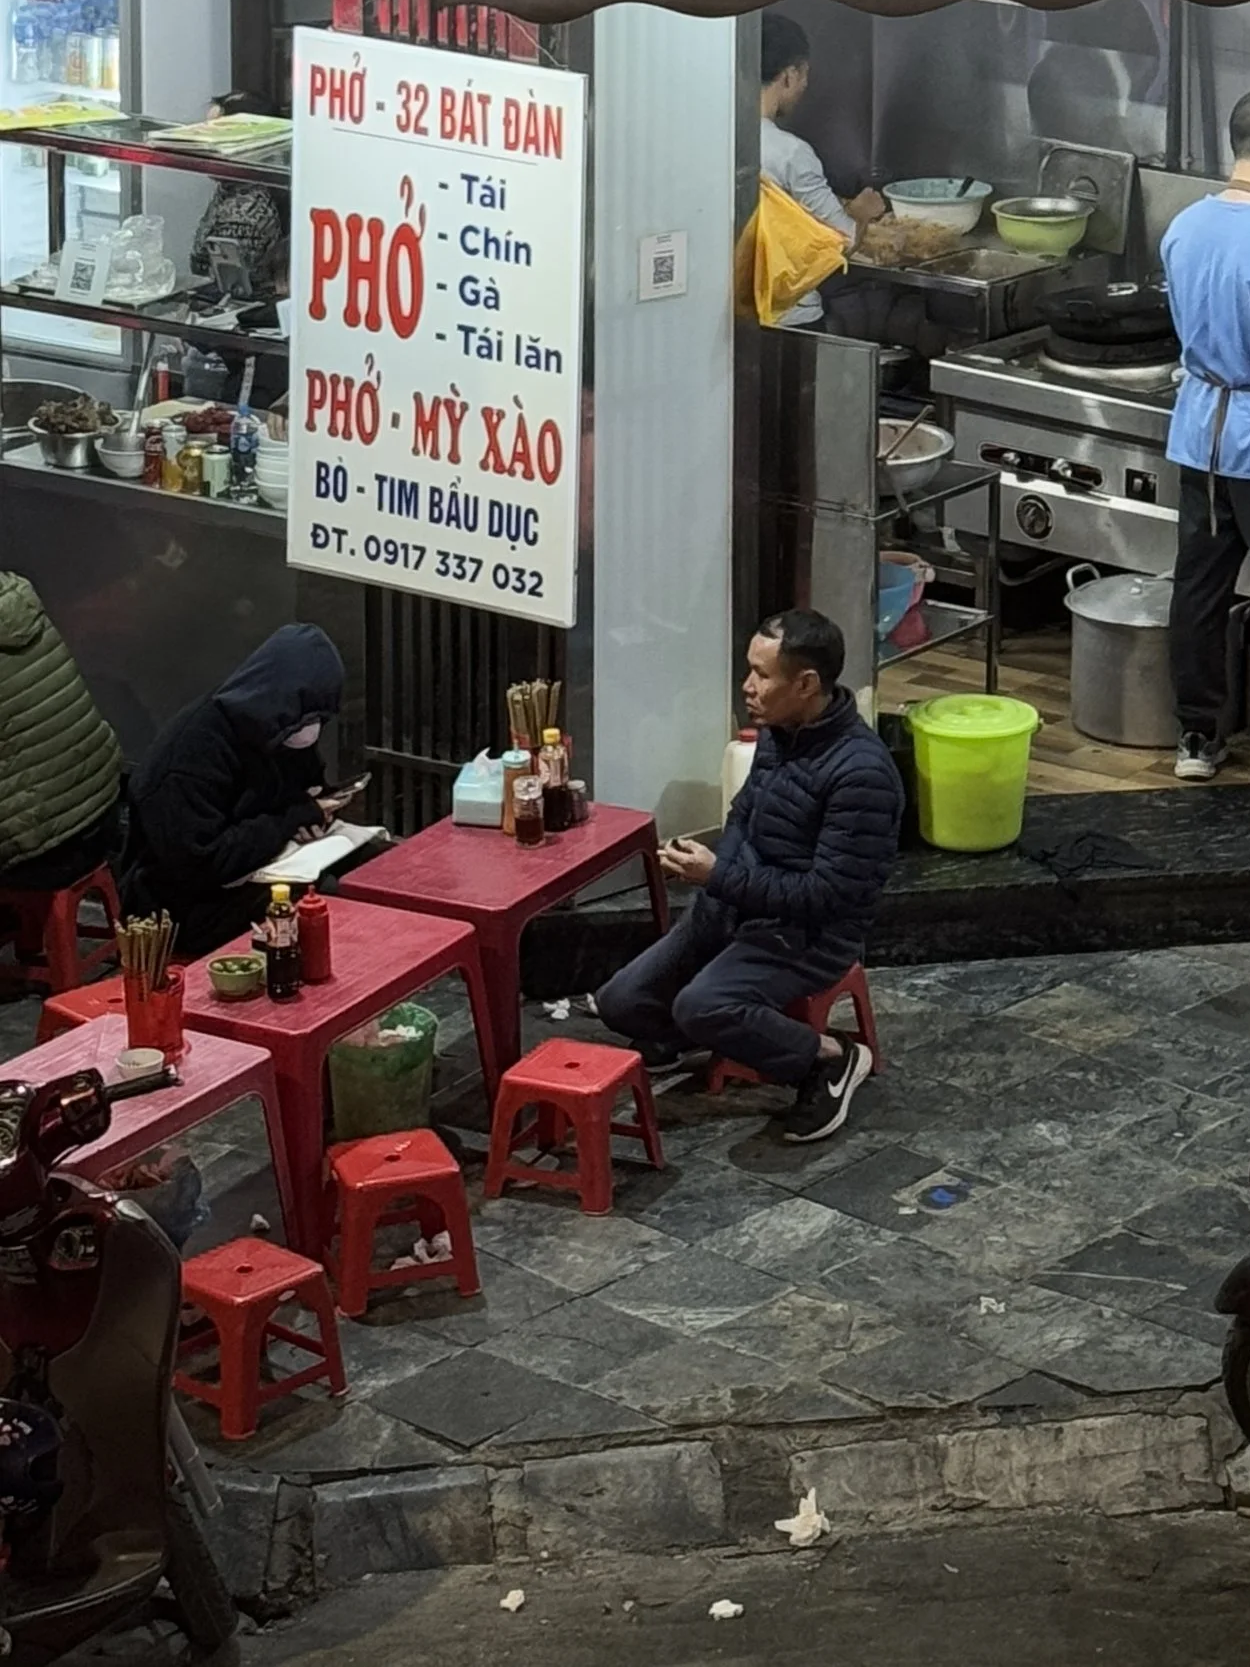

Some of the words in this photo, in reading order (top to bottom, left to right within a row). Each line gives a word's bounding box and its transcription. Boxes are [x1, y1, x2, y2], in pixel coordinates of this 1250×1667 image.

[309, 51, 367, 125] PHỞ
[396, 80, 430, 137] 32
[440, 79, 491, 147] BÁT
[503, 89, 564, 160] ĐÀN
[460, 173, 506, 211] Tái
[308, 174, 427, 340] PHỞ
[460, 225, 532, 267] Chín
[459, 275, 500, 311] Gà
[457, 324, 504, 363] Tái
[515, 334, 563, 374] lăn
[305, 352, 381, 446] PHỞ
[412, 383, 469, 465] MỲ
[479, 395, 563, 486] XÀO
[315, 456, 348, 504] BÒ
[374, 473, 420, 521] TIM
[428, 475, 479, 533] BẦU
[488, 499, 540, 551] DỤC
[310, 523, 356, 556] ĐT.
[364, 535, 427, 571] 0917
[435, 550, 484, 583] 337
[492, 563, 544, 598] 032
